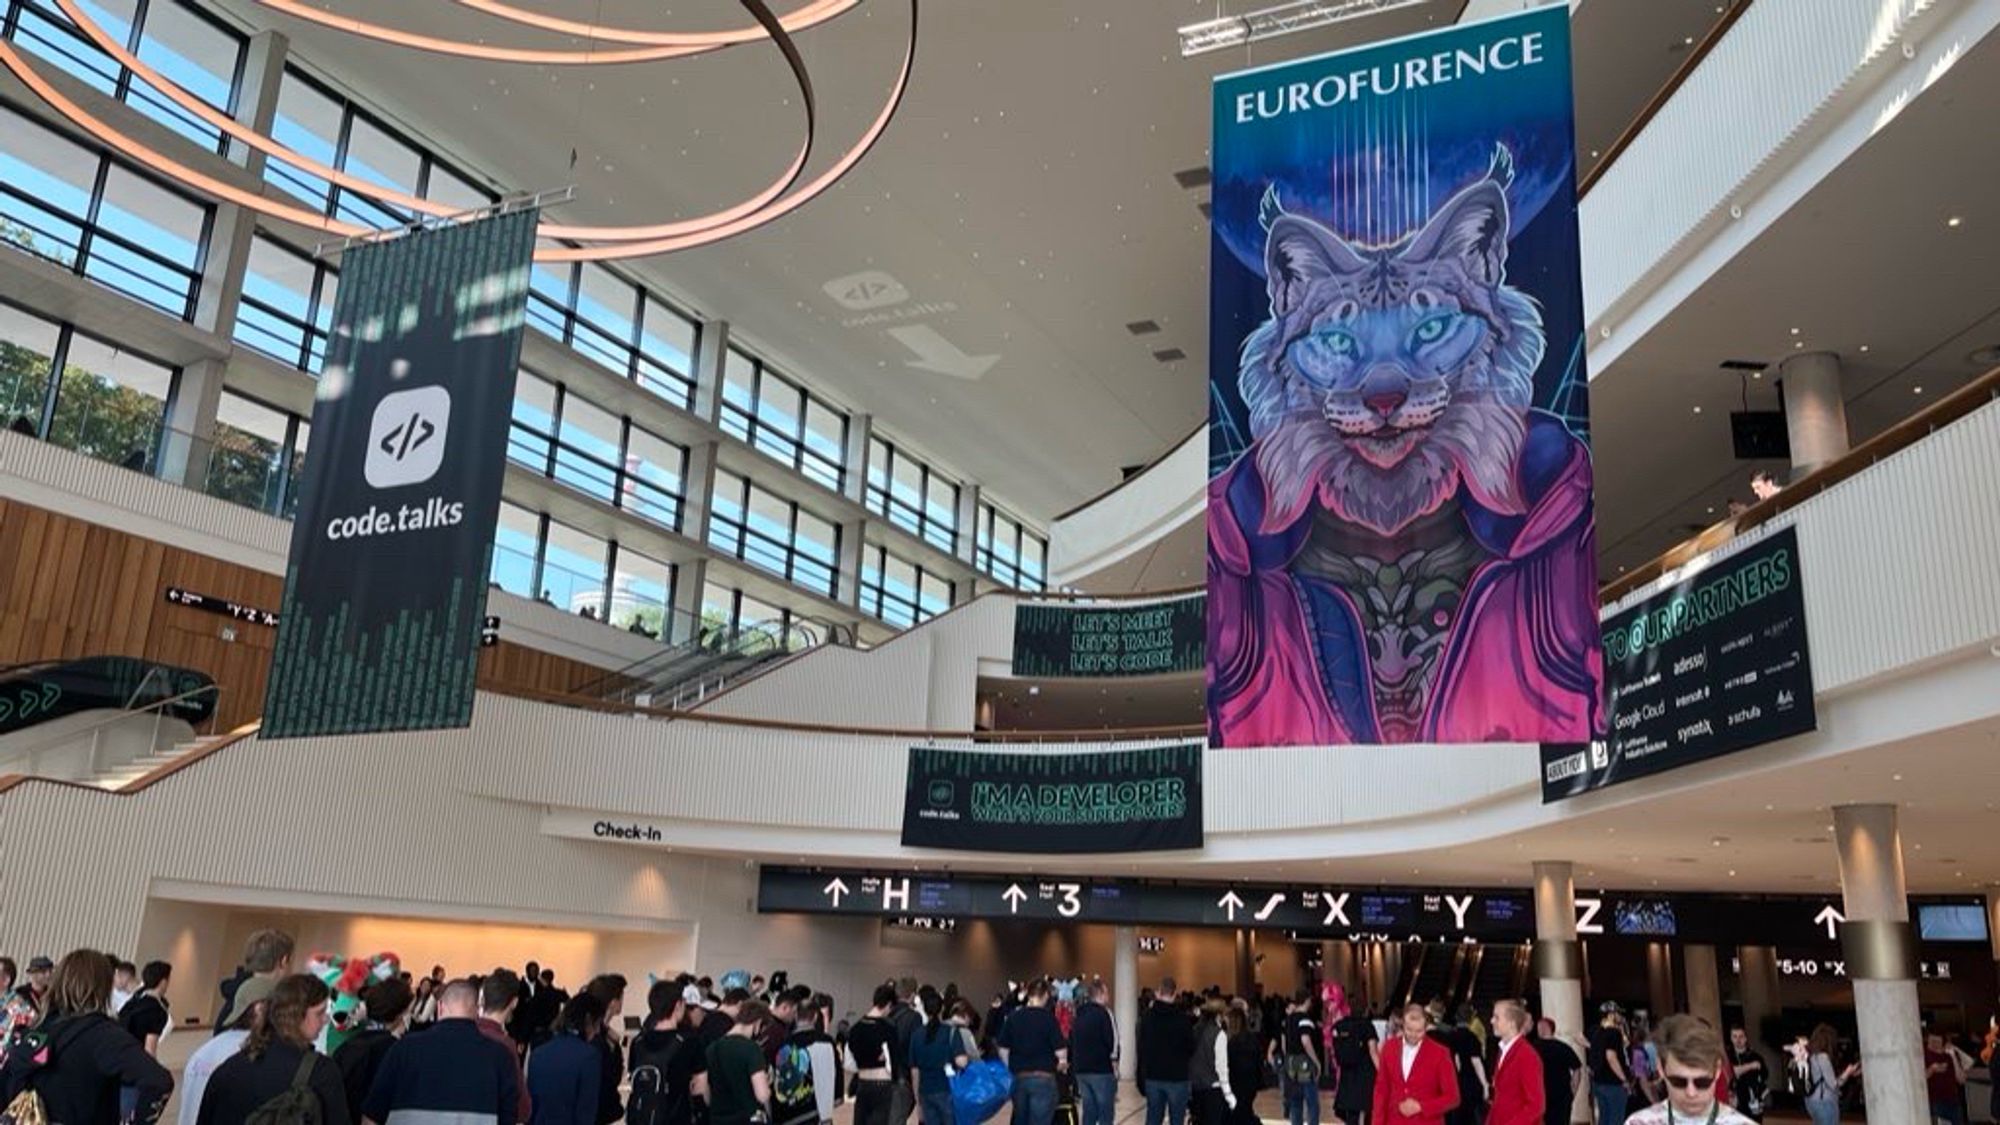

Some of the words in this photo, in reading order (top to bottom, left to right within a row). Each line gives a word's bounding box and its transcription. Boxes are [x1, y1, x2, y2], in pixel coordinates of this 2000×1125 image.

[1236, 32, 1544, 124] EUROFURENCE
[327, 497, 464, 541] code.talks
[1073, 612, 1120, 632] LET'S
[1121, 608, 1174, 632] MEET
[1602, 628, 1629, 667] TO
[1629, 606, 1673, 655] OUR
[1671, 549, 1790, 635] PARTNERS
[1072, 632, 1119, 652] LET'S
[1121, 628, 1173, 651] TALK
[1070, 652, 1118, 672] LET'S
[1120, 649, 1173, 672] CODE
[1674, 652, 1705, 675] adesso
[1615, 708, 1641, 731] Google
[1642, 698, 1665, 720] Cloud
[971, 782, 1011, 807] I'M
[1012, 783, 1037, 807] A
[1038, 778, 1186, 808] DEVELOPER
[593, 821, 662, 841] Check-In
[883, 878, 909, 911] H
[1057, 884, 1080, 917] 3
[1322, 892, 1351, 926] X
[1444, 894, 1473, 929] Y
[1574, 899, 1604, 933] Z
[1783, 959, 1818, 976] 5-10
[1834, 960, 1846, 977] X
